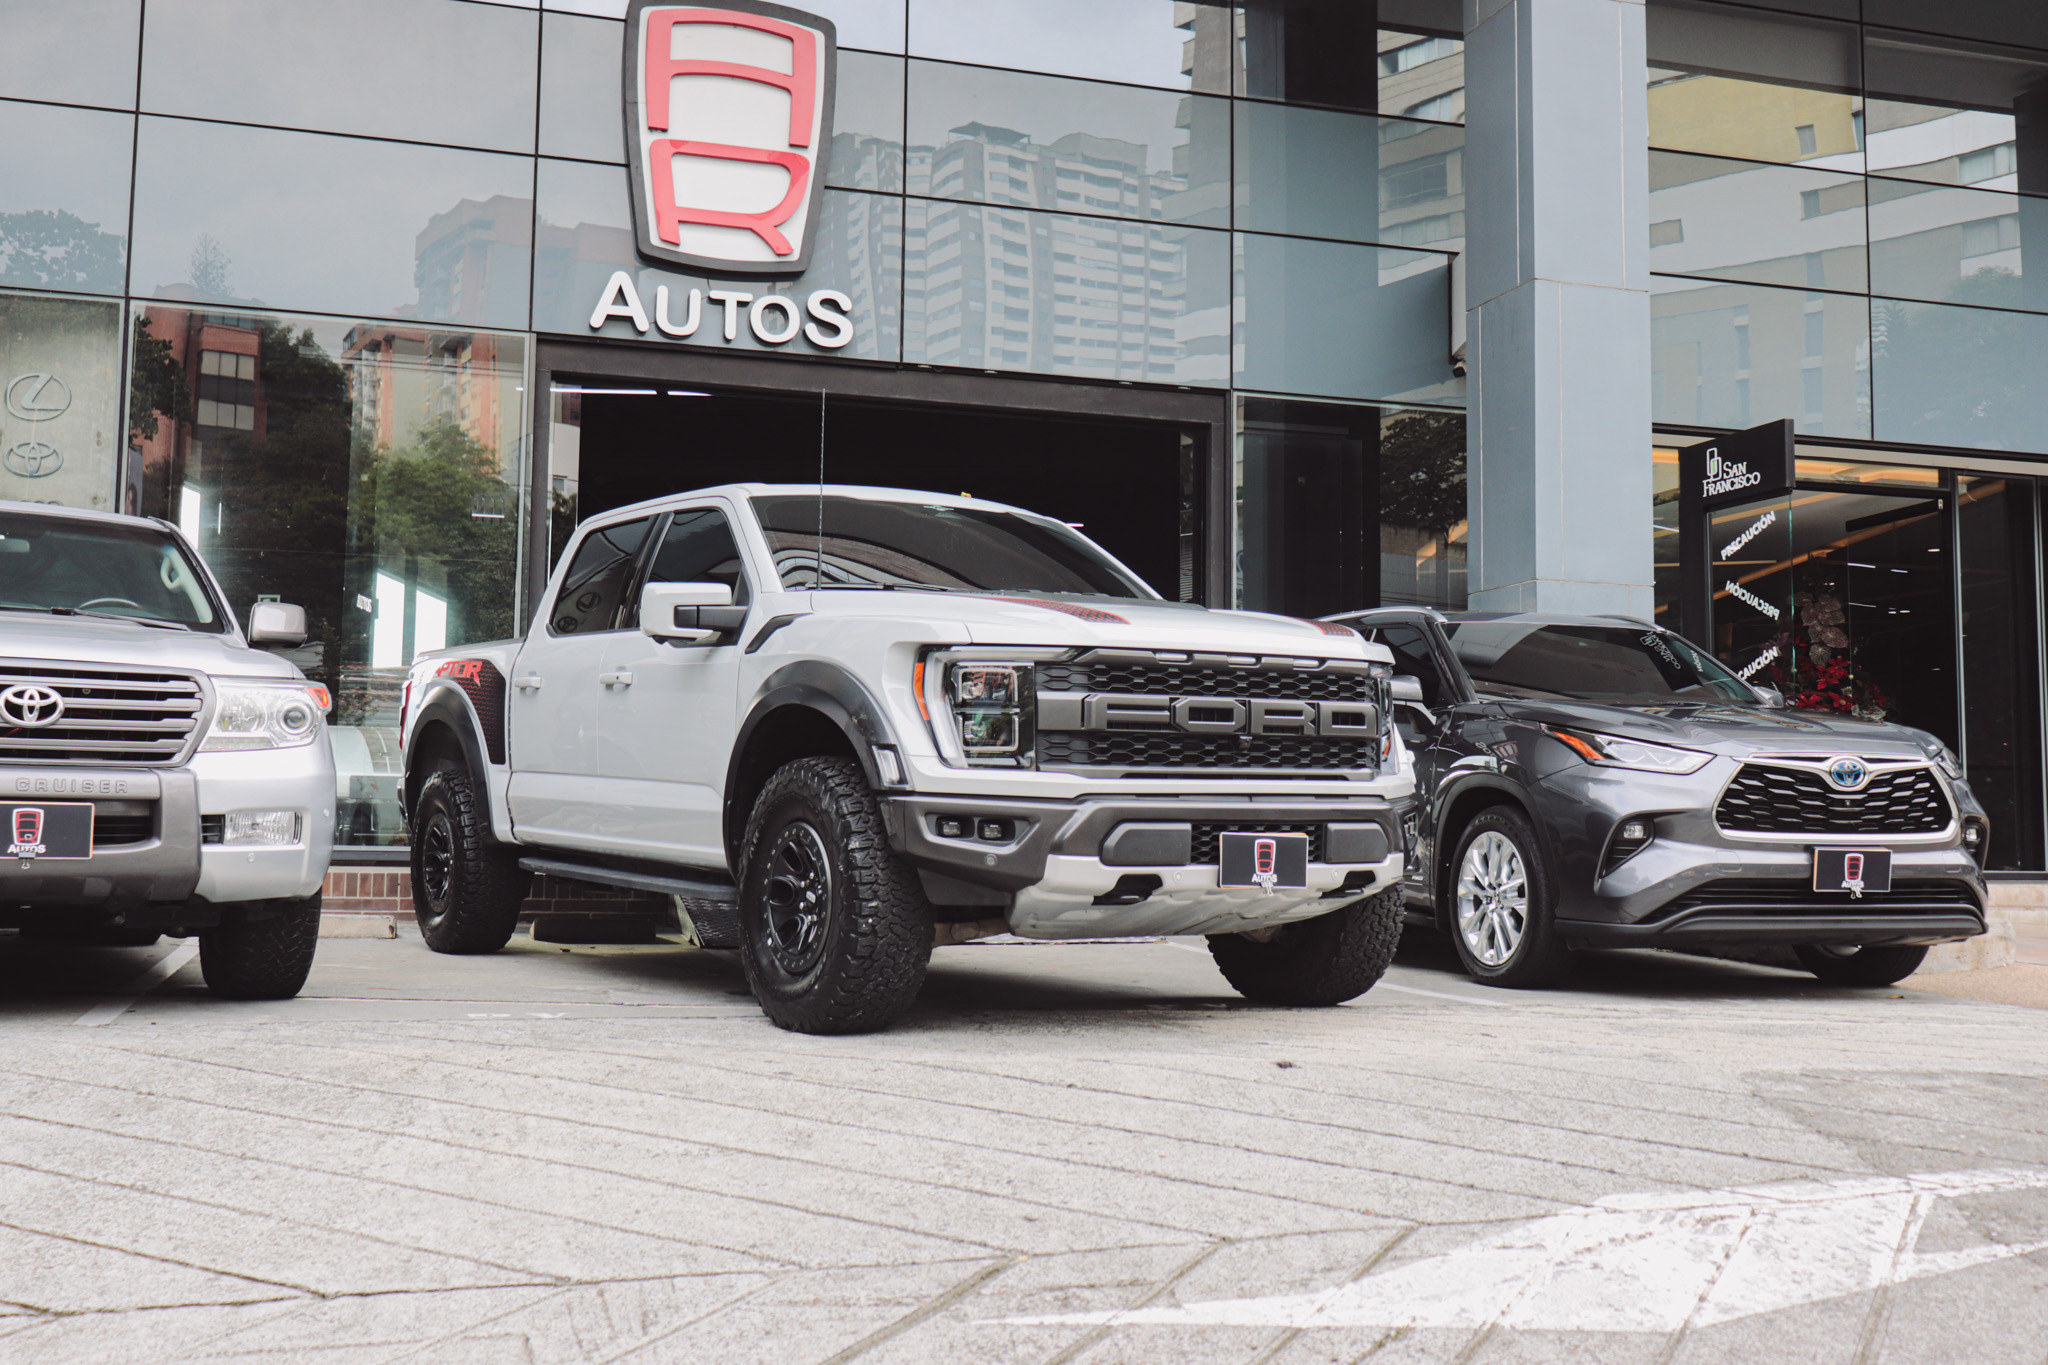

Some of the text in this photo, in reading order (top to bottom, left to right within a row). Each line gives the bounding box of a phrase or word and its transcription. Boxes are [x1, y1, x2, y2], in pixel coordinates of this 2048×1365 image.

[589, 271, 854, 349] AUTOS
[1723, 461, 1747, 479] SAN
[1702, 471, 1761, 497] FRANCISCO
[1720, 510, 1776, 560] PRECAUCIÓN
[1737, 646, 1778, 681] CAUCIÓN
[1084, 692, 1378, 737] FORD
[15, 777, 128, 794] CRUISER
[7, 844, 46, 854] AUTOS
[1251, 873, 1278, 883] AUTOS
